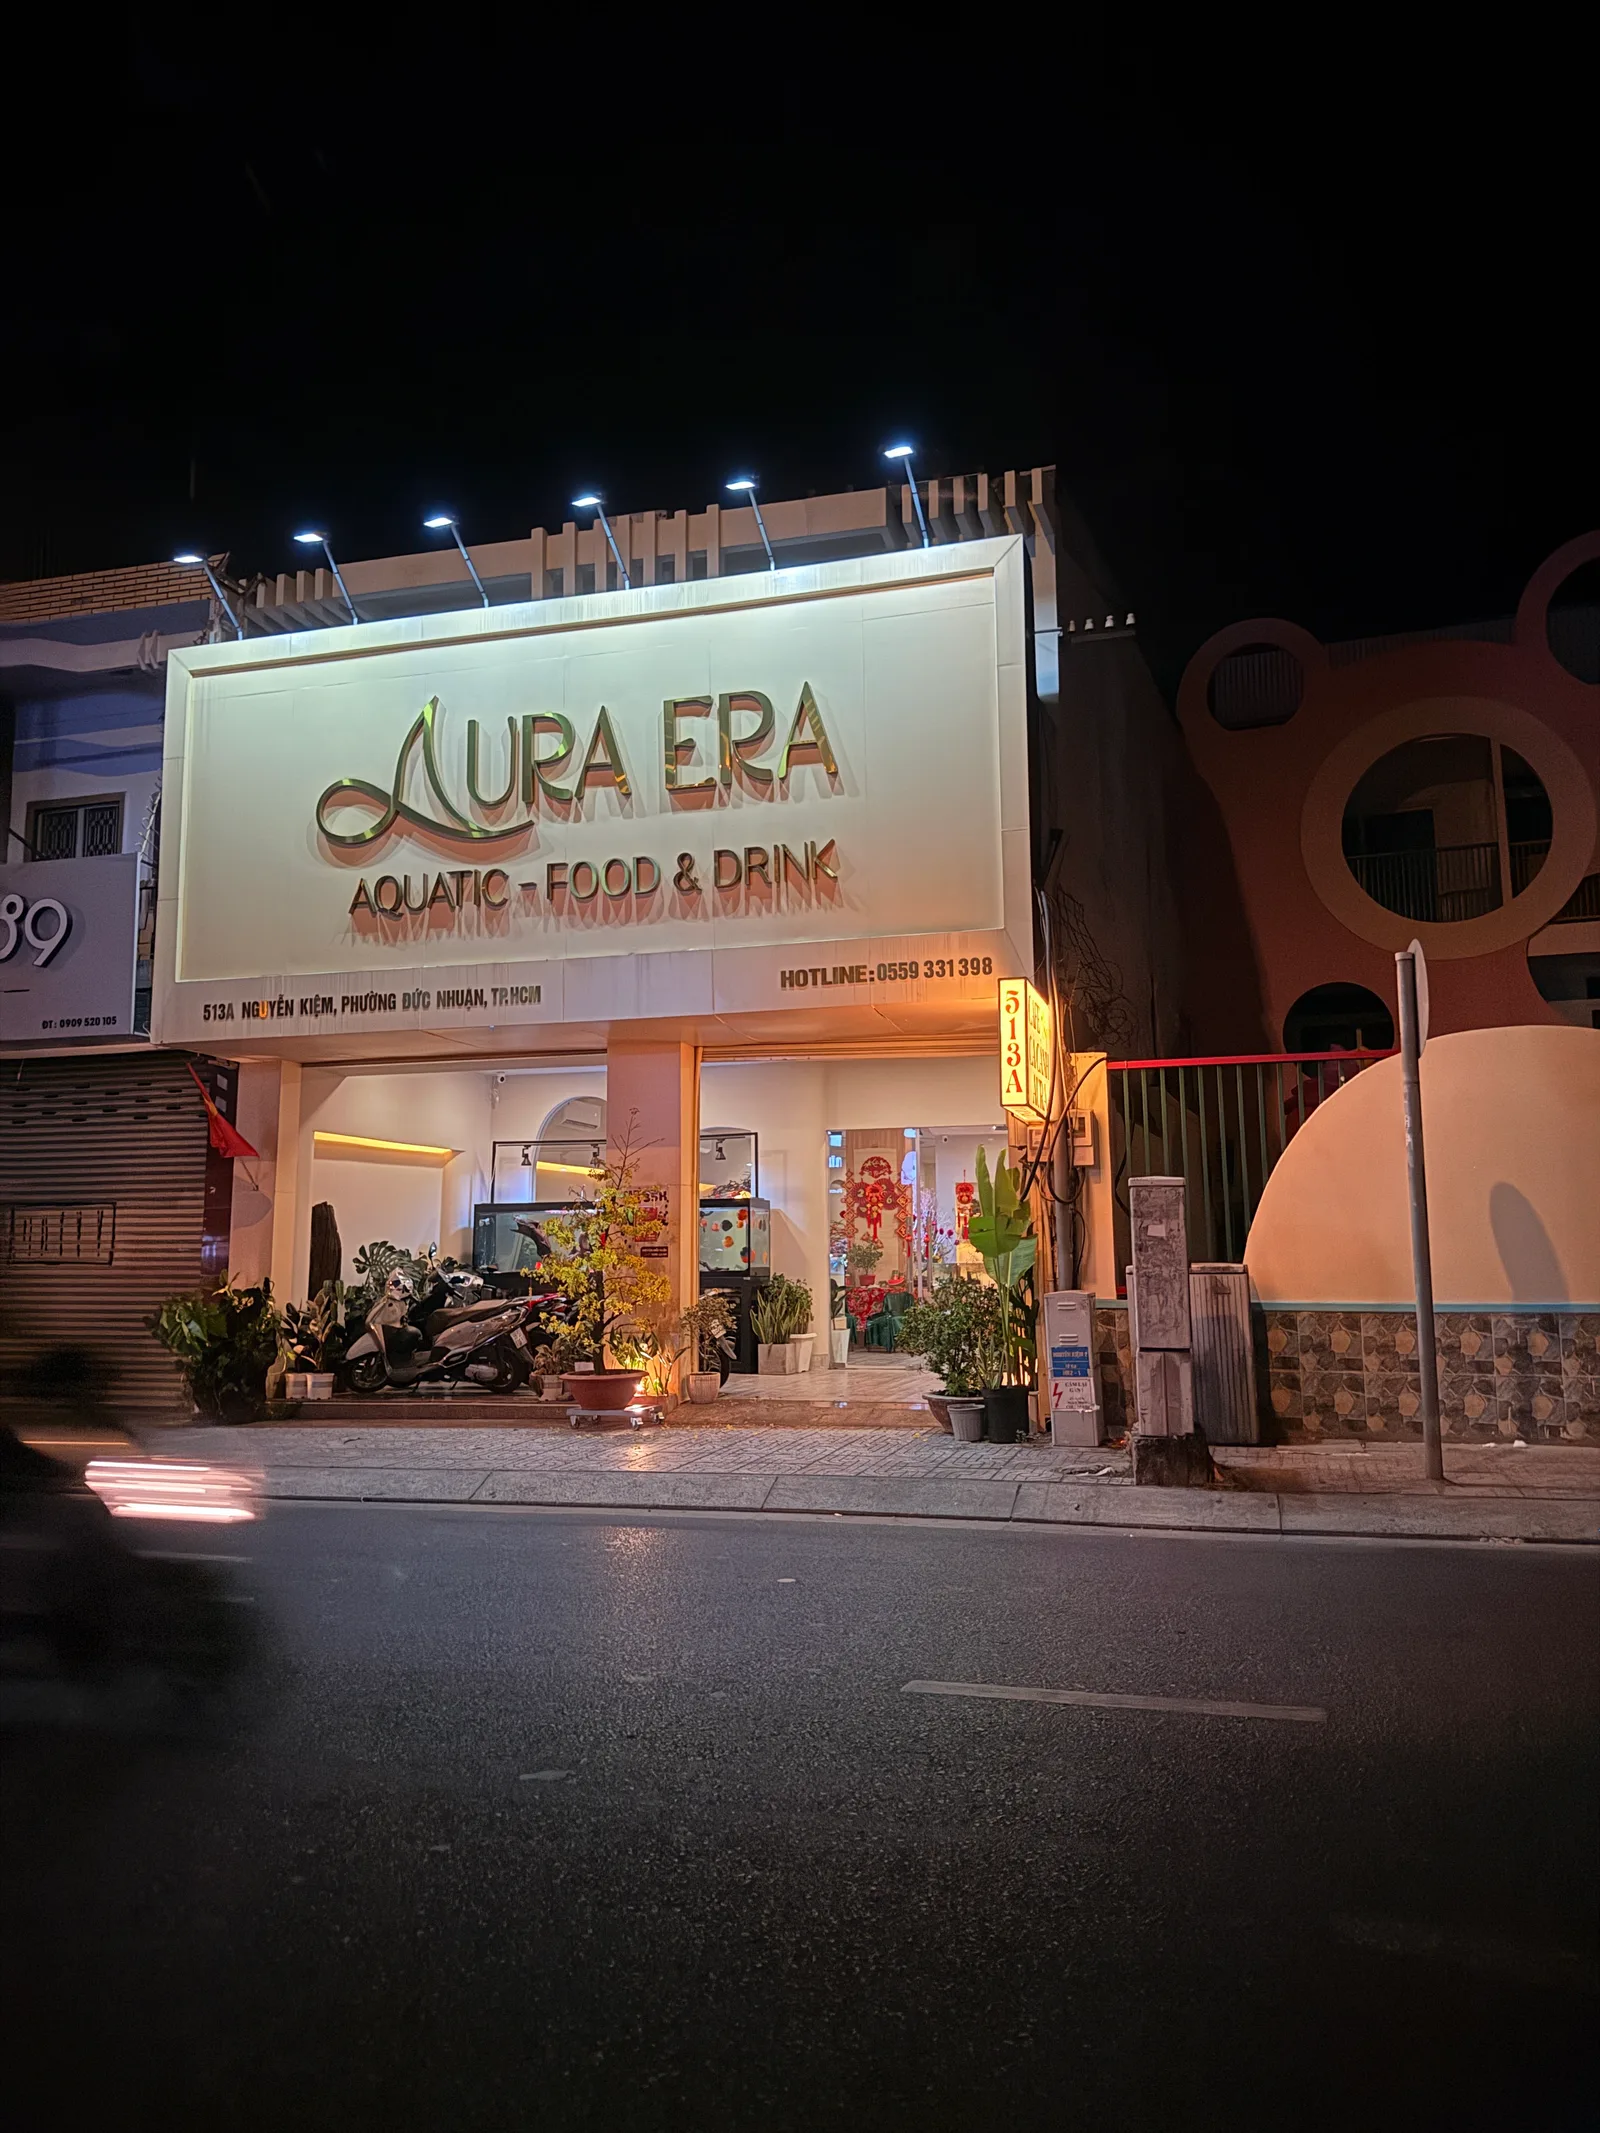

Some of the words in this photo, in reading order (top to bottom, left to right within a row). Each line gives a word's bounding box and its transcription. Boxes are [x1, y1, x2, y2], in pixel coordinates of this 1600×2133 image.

[663, 681, 838, 791] ERA
[348, 868, 509, 920] AQUATIC
[546, 855, 661, 901] FOOD
[673, 852, 702, 893] &
[714, 838, 838, 889] DRINK
[923, 959, 954, 978] 331
[958, 956, 993, 977] 398
[59, 1018, 82, 1028] 0909
[84, 1017, 100, 1027] 520
[102, 1016, 117, 1026] 105
[203, 1003, 235, 1021] 513A
[242, 993, 294, 1020] NGUYỄN
[300, 994, 337, 1018] KIỆM,
[341, 990, 397, 1014] PHƯỜNG
[402, 988, 431, 1012] ĐỨC
[436, 986, 488, 1011] NHUẬN,
[491, 985, 541, 1006] TP.HCM
[1005, 990, 1023, 1093] 513A
